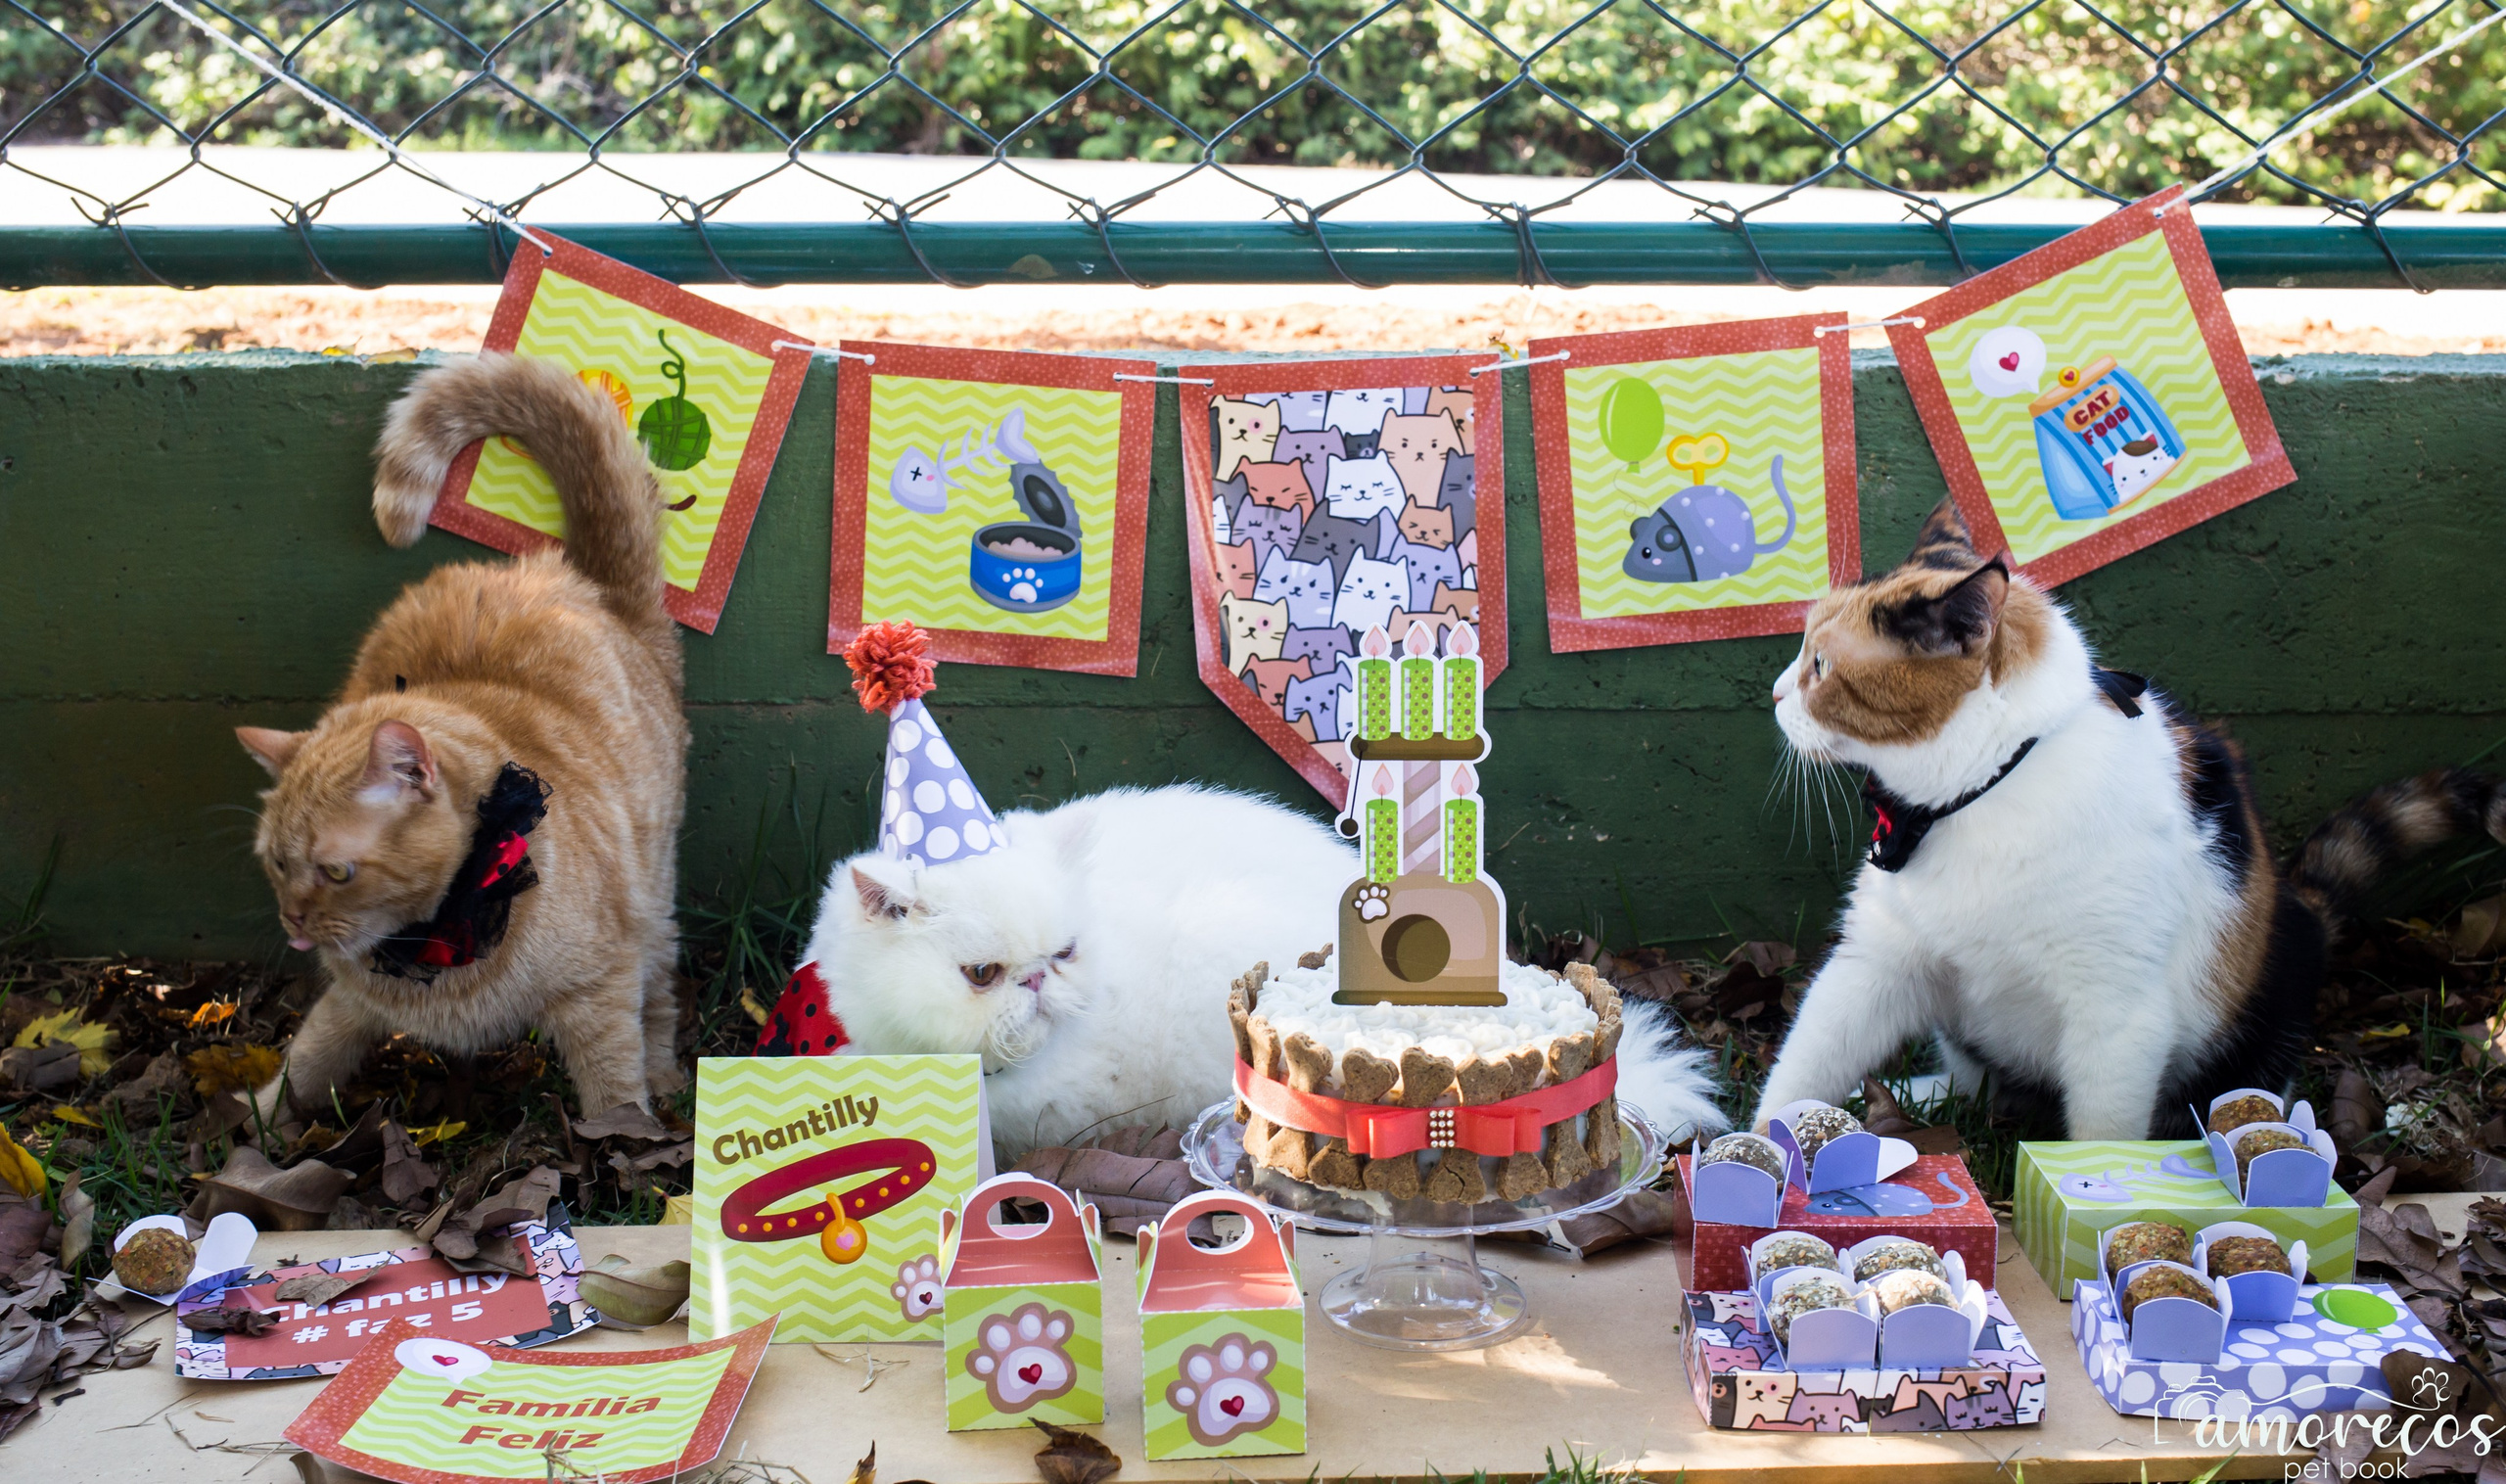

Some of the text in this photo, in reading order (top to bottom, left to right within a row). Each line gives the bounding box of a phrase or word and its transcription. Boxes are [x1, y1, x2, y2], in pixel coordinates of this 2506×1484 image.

[2072, 390, 2112, 426] CAT
[2081, 405, 2130, 446] FOOD
[712, 1093, 879, 1166] Chantilly
[451, 1299, 485, 1322] 5
[441, 1388, 662, 1417] Família
[457, 1424, 606, 1450] Feliz
